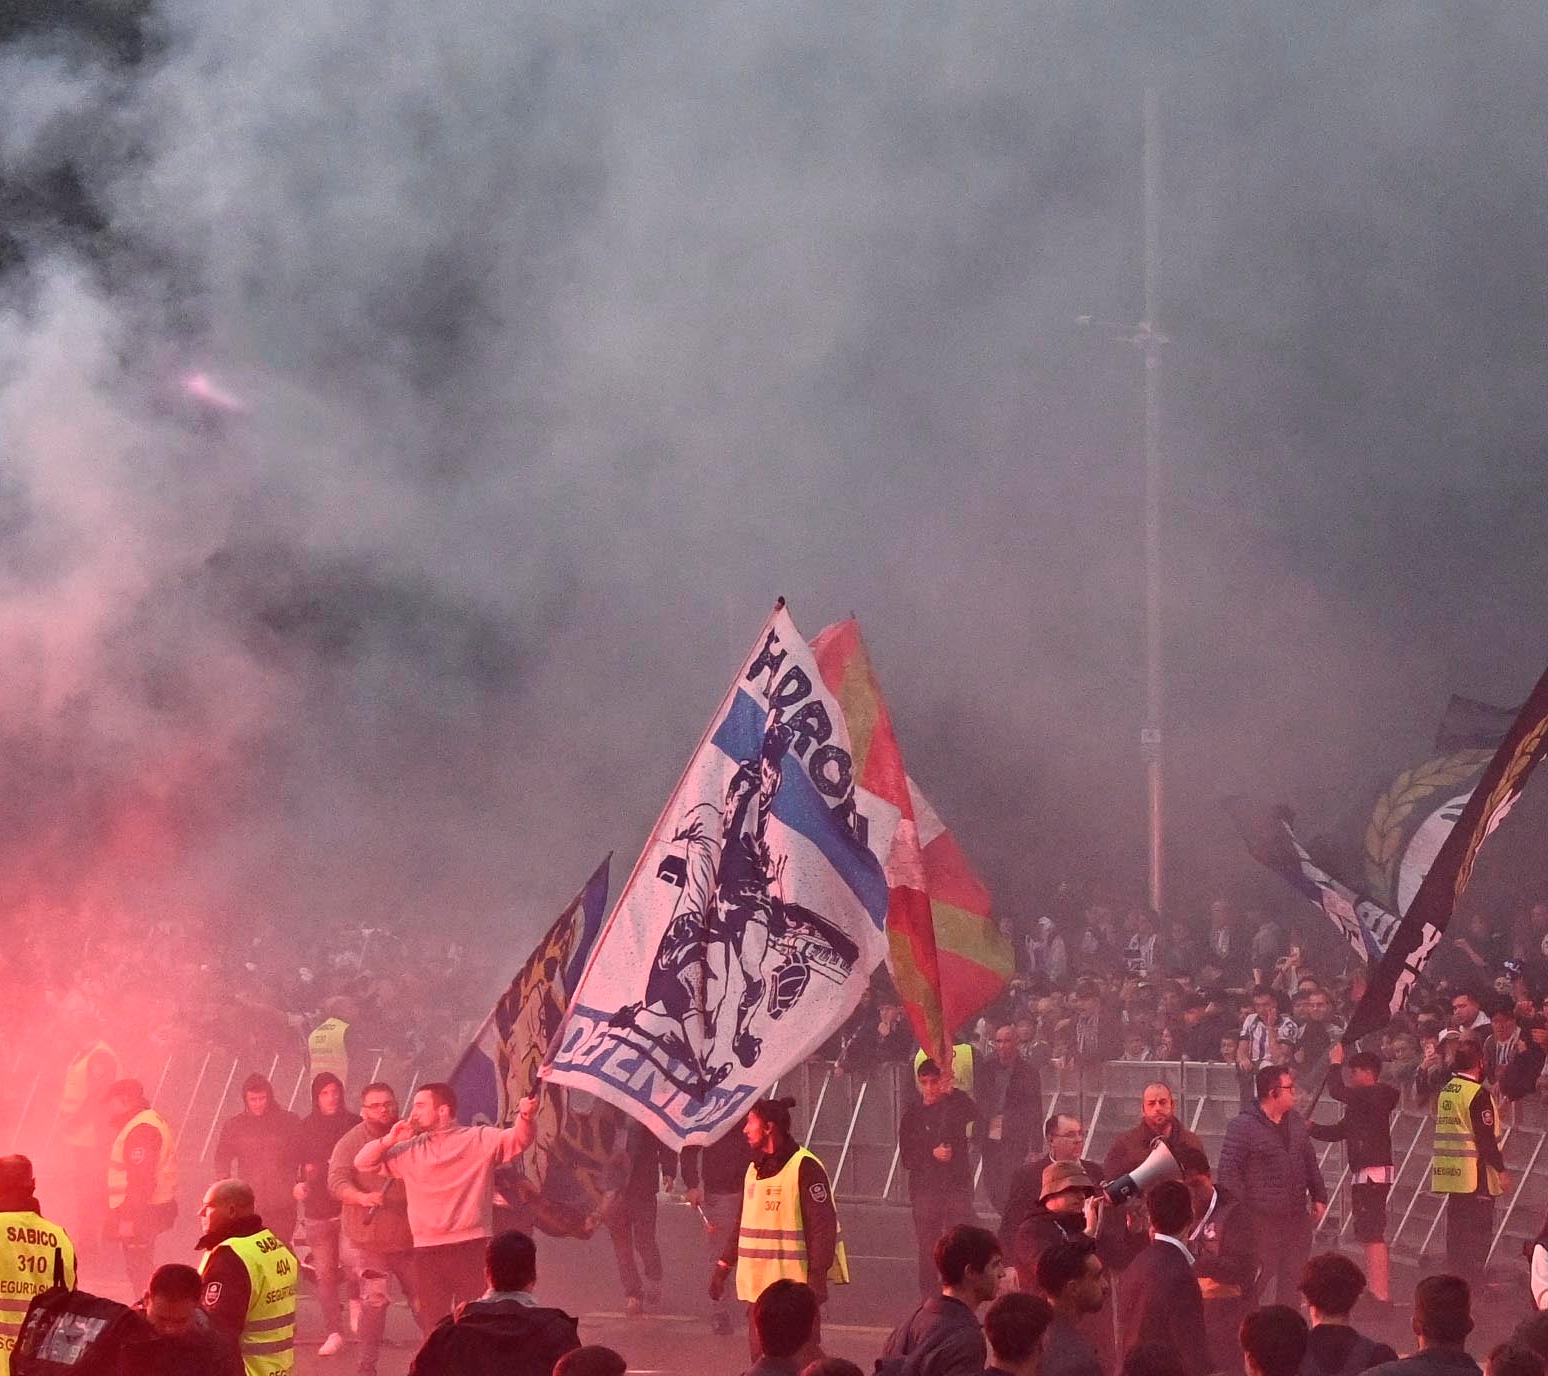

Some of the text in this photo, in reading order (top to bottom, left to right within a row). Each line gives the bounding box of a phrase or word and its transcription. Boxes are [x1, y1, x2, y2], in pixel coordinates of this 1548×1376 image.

[6, 1226, 58, 1248] SABICO
[17, 1254, 47, 1274] 310
[276, 1258, 292, 1277] 404
